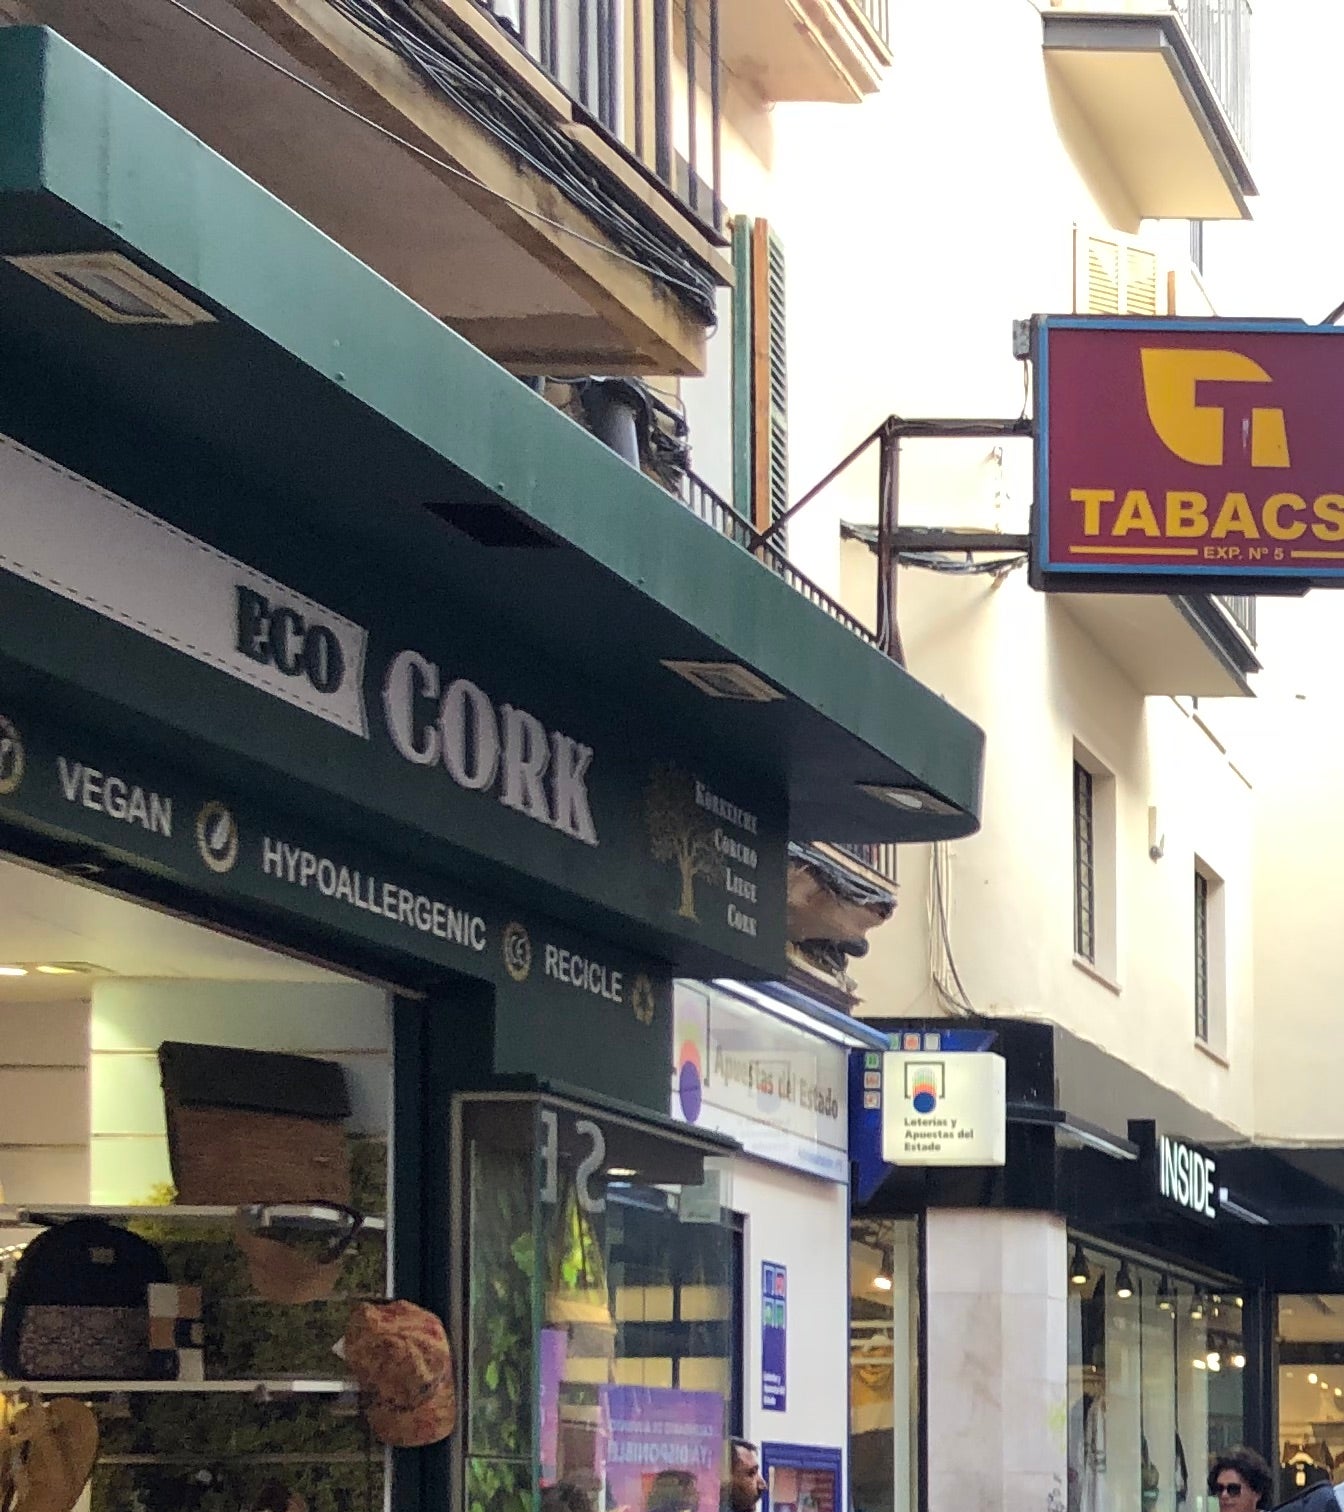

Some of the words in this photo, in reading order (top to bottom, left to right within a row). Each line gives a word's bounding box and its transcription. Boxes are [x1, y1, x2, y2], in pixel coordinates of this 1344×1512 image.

[1203, 546, 1243, 560] EXP.
[1273, 547, 1285, 560] 5
[234, 584, 347, 694] ECO
[382, 649, 600, 848] CORK
[57, 755, 174, 838] VEGAN
[262, 836, 487, 951] HYPOALLERGENIC
[544, 943, 623, 1003] RECICLE
[950, 1119, 957, 1129] y
[904, 1130, 955, 1140] Apuestas
[957, 1129, 974, 1139] del
[904, 1142, 941, 1152] Estado
[1160, 1133, 1216, 1219] INSIDE
